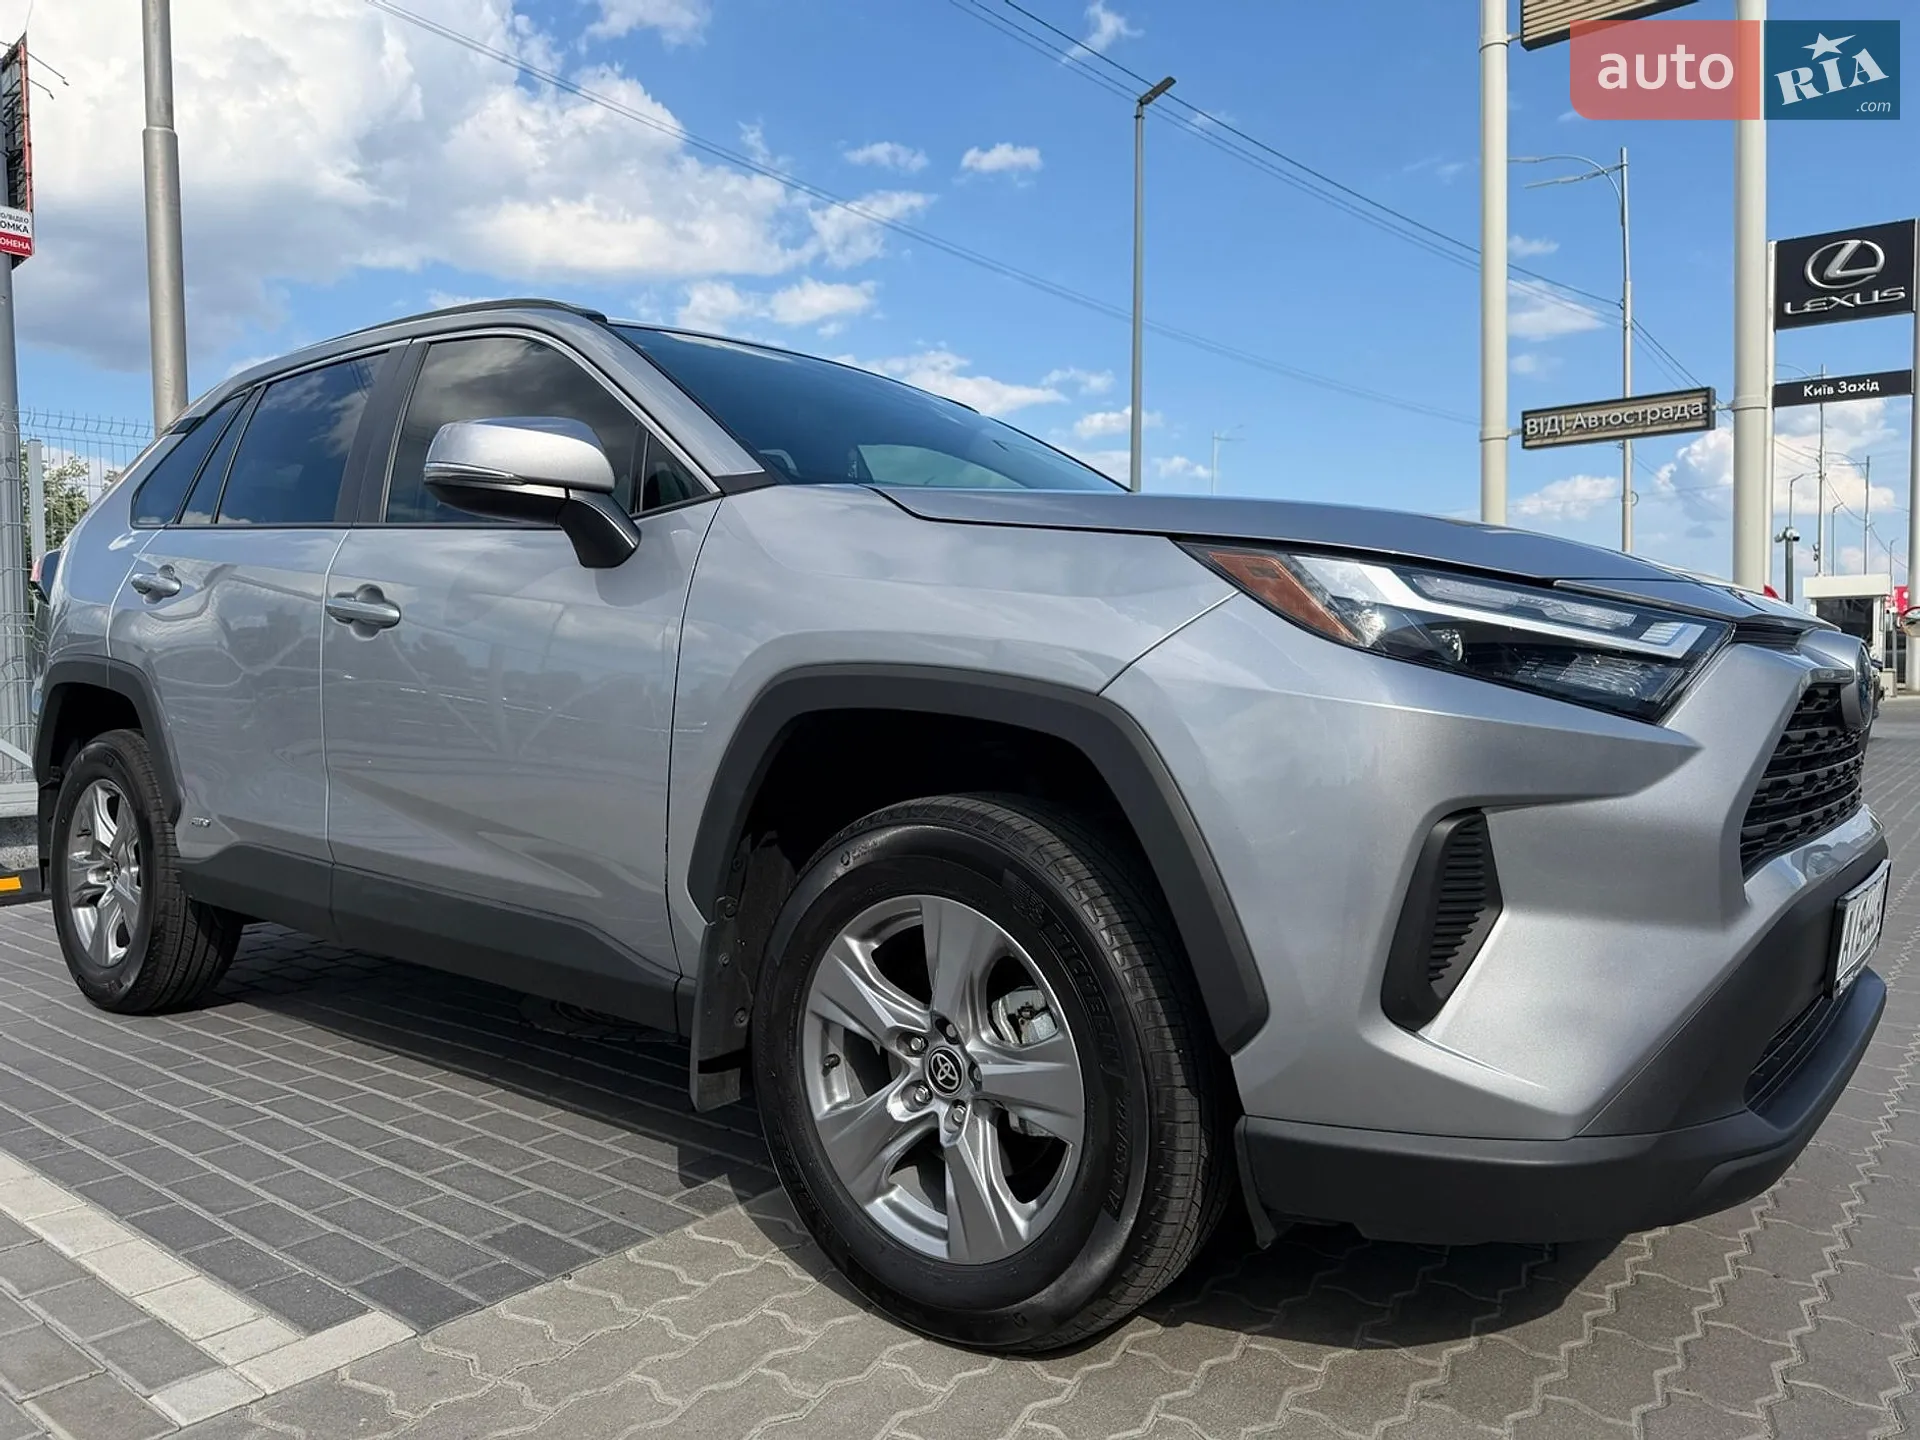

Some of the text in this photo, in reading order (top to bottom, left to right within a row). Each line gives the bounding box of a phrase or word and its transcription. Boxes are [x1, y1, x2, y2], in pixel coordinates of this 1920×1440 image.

[1783, 286, 1906, 315] LEXUS
[1803, 379, 1880, 397] Київ Захід
[1572, 402, 1703, 430] Автострада
